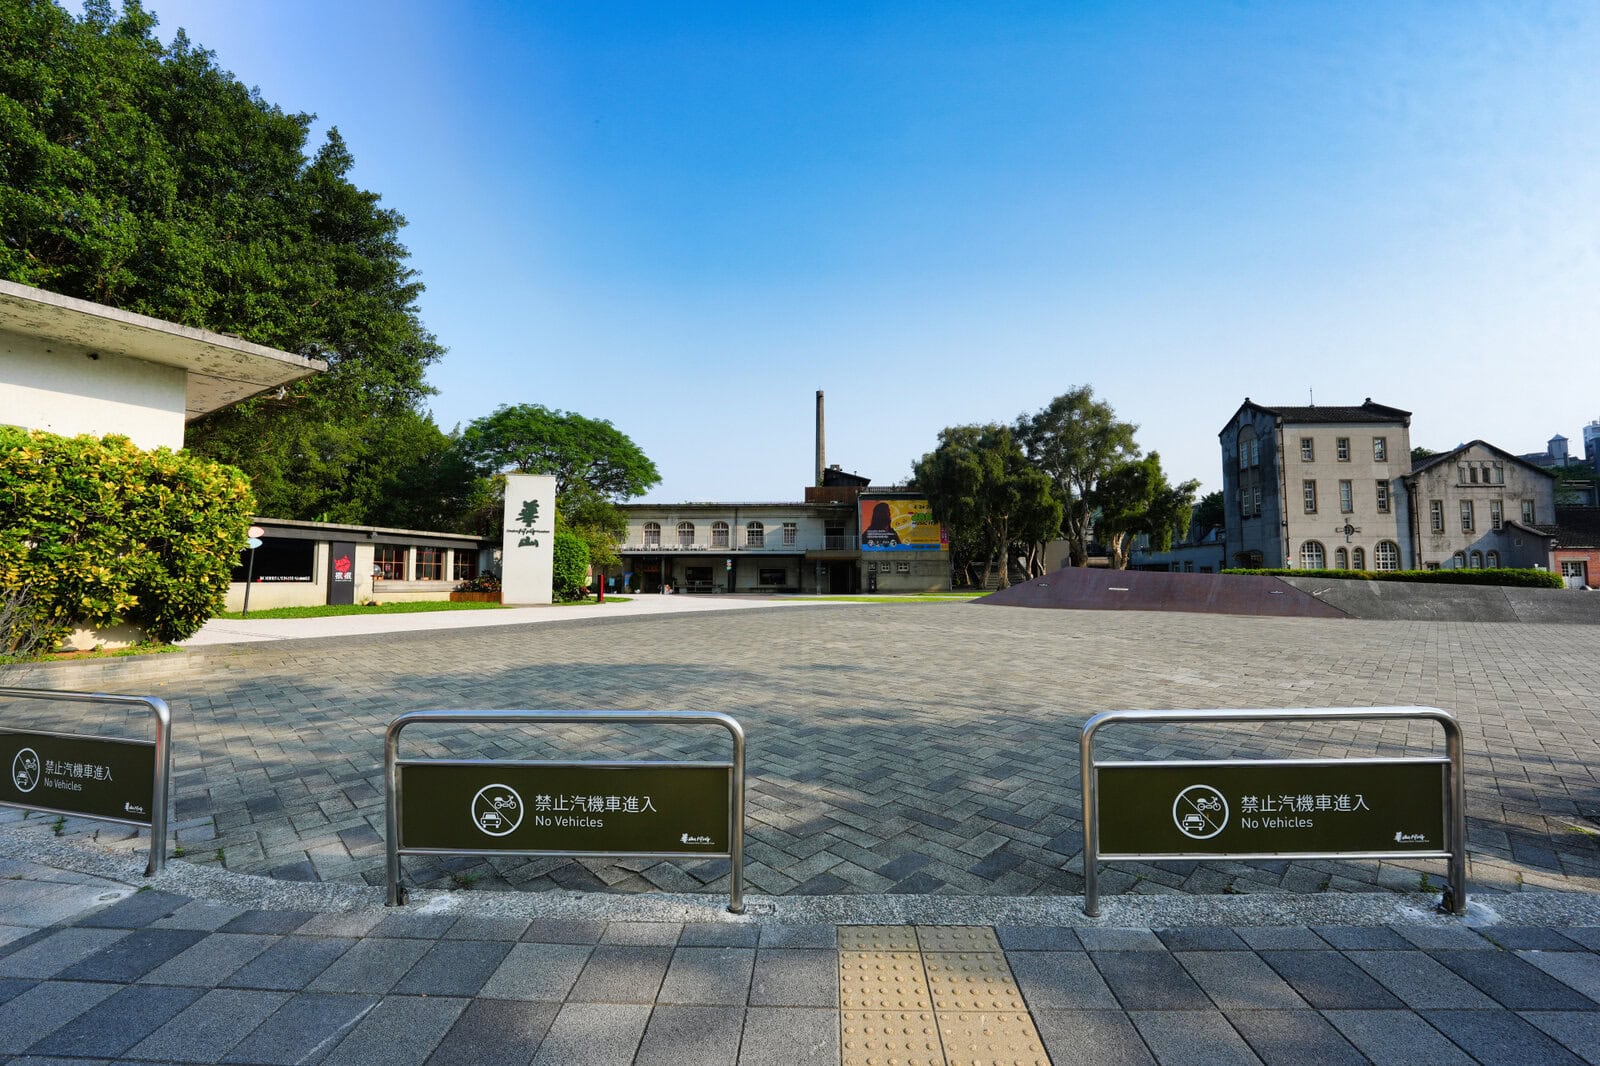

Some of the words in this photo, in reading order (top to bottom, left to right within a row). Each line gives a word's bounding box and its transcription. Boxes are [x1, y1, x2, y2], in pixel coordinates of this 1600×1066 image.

[44, 760, 113, 781] 禁止汽機車進入
[44, 778, 53, 788] No
[54, 780, 82, 791] Vehicles
[535, 794, 657, 813] 禁止汽機車進入
[1241, 794, 1370, 813] 禁止汽機車進入
[535, 816, 551, 826] No
[554, 816, 603, 828] Vehicles
[1241, 817, 1259, 829] No
[1262, 816, 1313, 828] Vehicles
